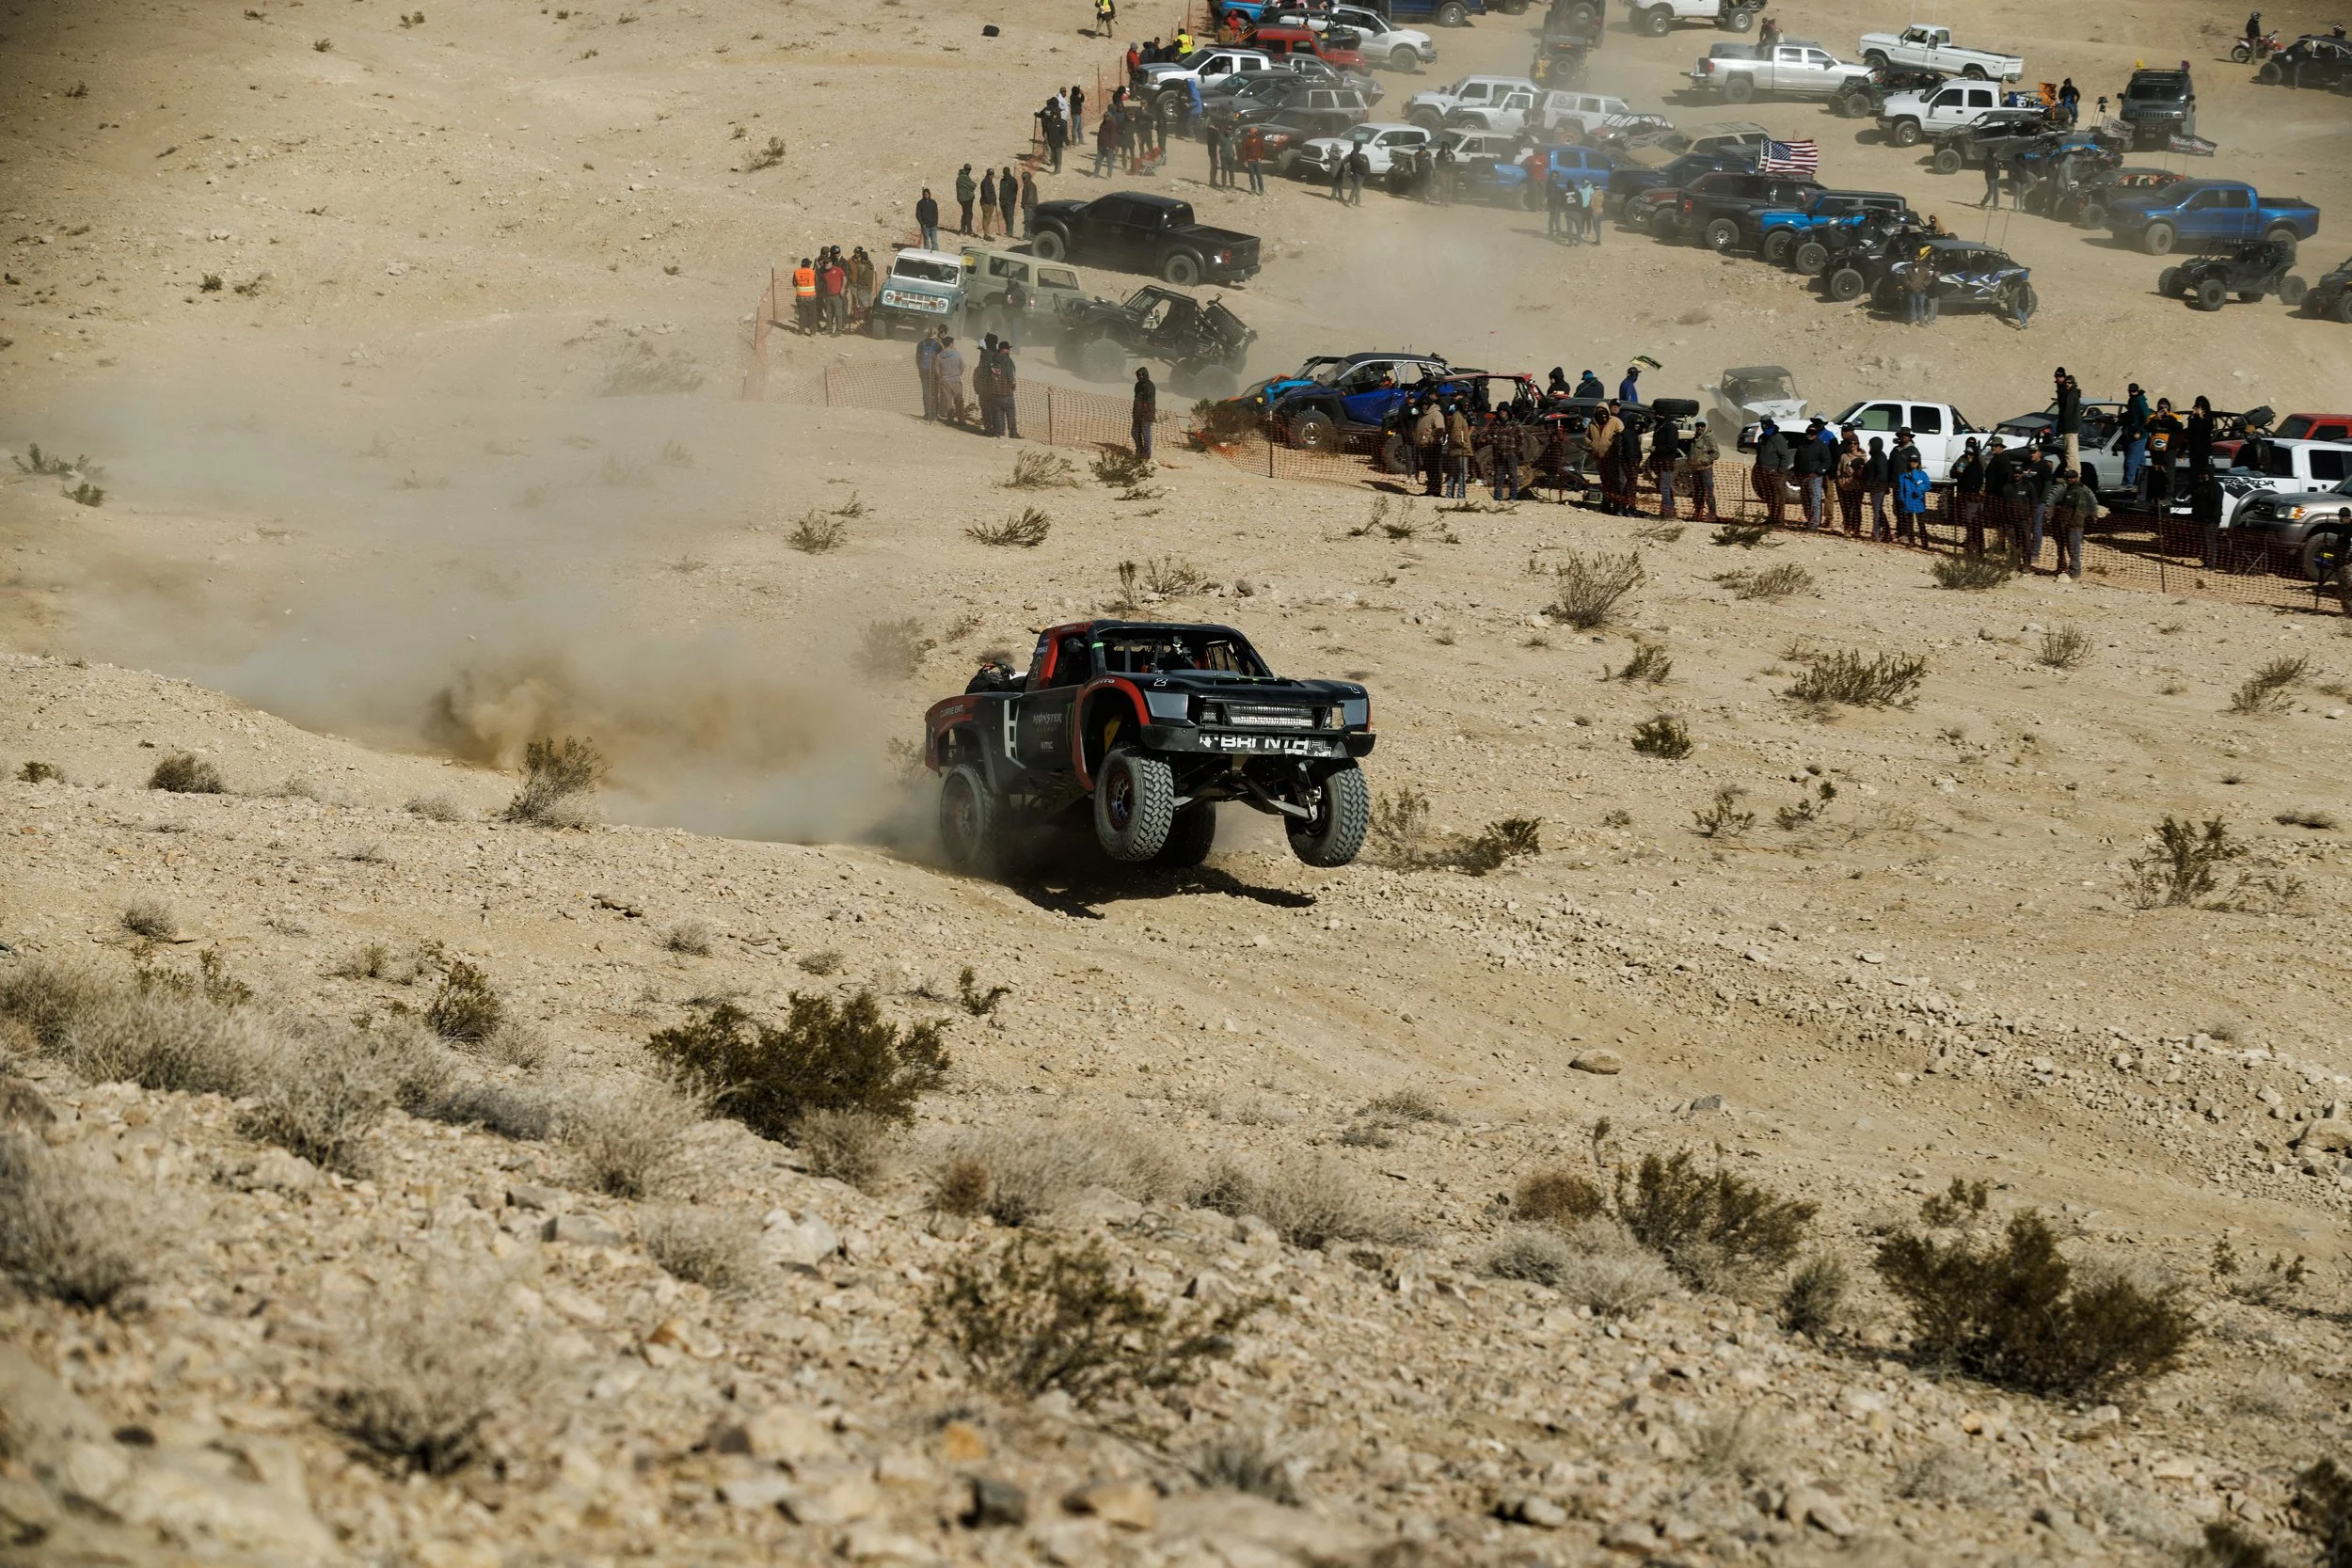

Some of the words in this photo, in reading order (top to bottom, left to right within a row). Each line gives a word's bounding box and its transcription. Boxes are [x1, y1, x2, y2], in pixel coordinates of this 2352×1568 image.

[2223, 478, 2277, 489] RAPTOR
[1153, 677, 1168, 687] 2
[1032, 711, 1062, 724] MONSTER
